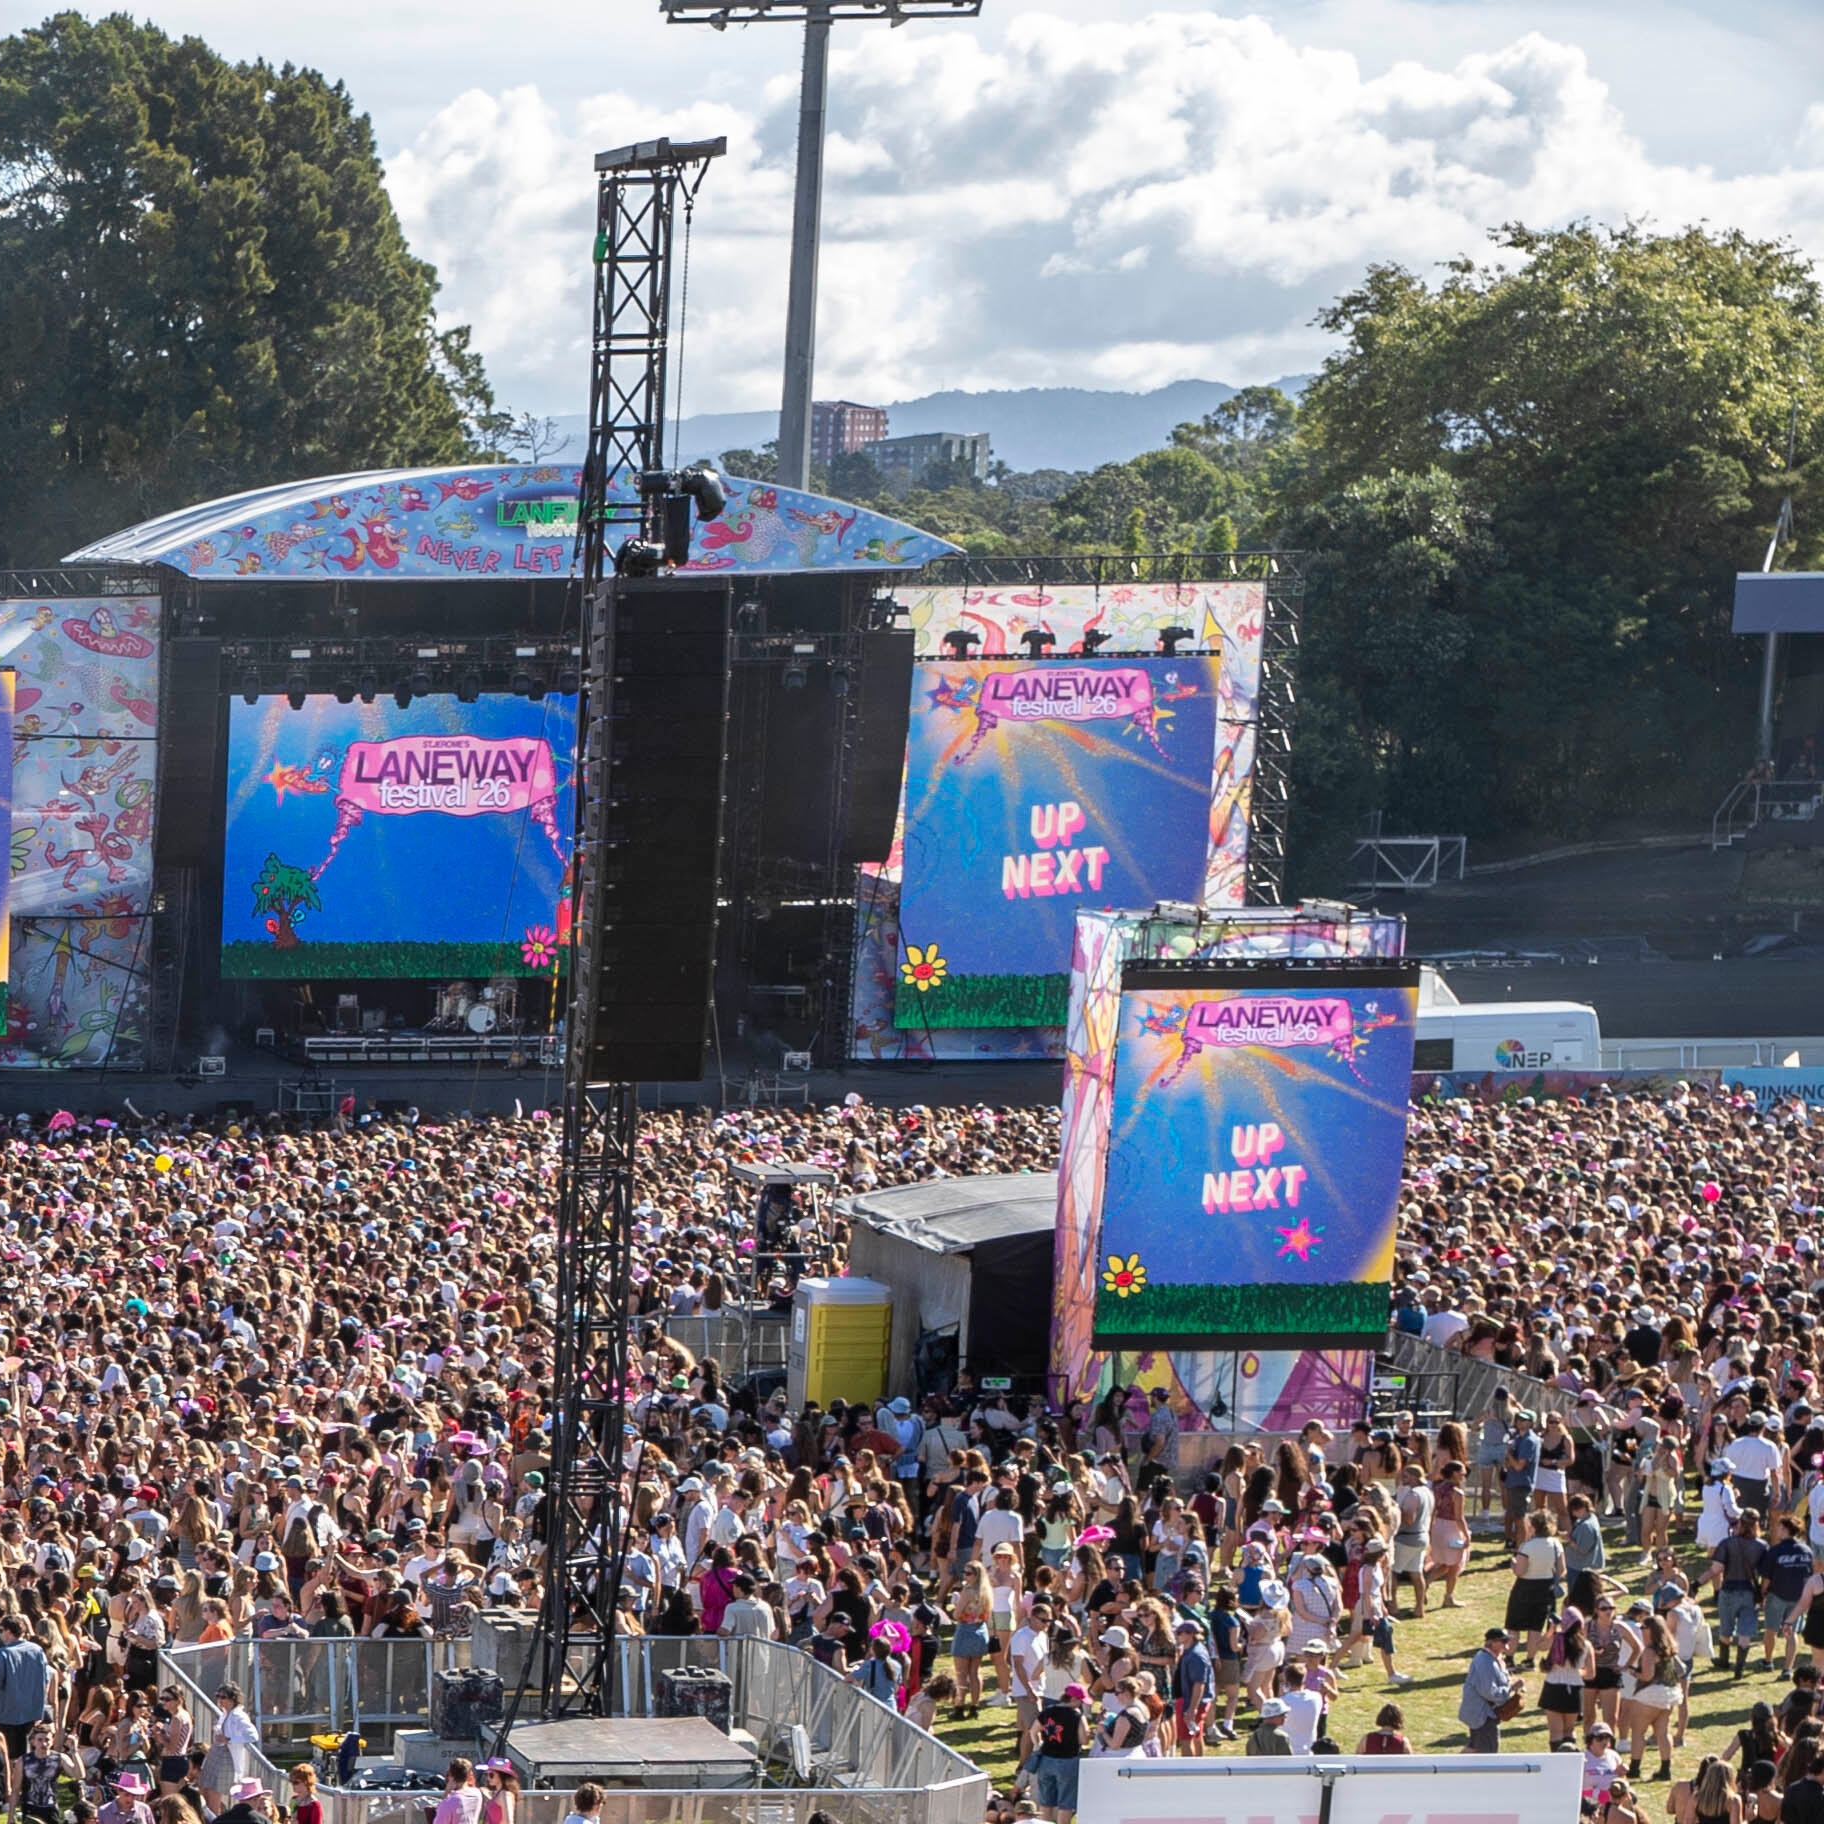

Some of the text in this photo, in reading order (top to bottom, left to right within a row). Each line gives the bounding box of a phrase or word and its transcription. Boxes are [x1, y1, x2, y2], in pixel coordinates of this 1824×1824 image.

[416, 534, 564, 573] NEVER LET
[992, 676, 1136, 700] LANEWAY
[1011, 696, 1082, 716] festival
[355, 750, 536, 784] LANEWAY
[379, 779, 466, 808] festival
[1031, 801, 1086, 849] UP
[1002, 846, 1110, 900] NEXT
[1197, 1005, 1338, 1028] LANEWAY
[1216, 1023, 1284, 1043] festival
[1512, 1052, 1552, 1068] NEP
[1231, 1122, 1286, 1168] UP
[1202, 1165, 1308, 1215] NEXT
